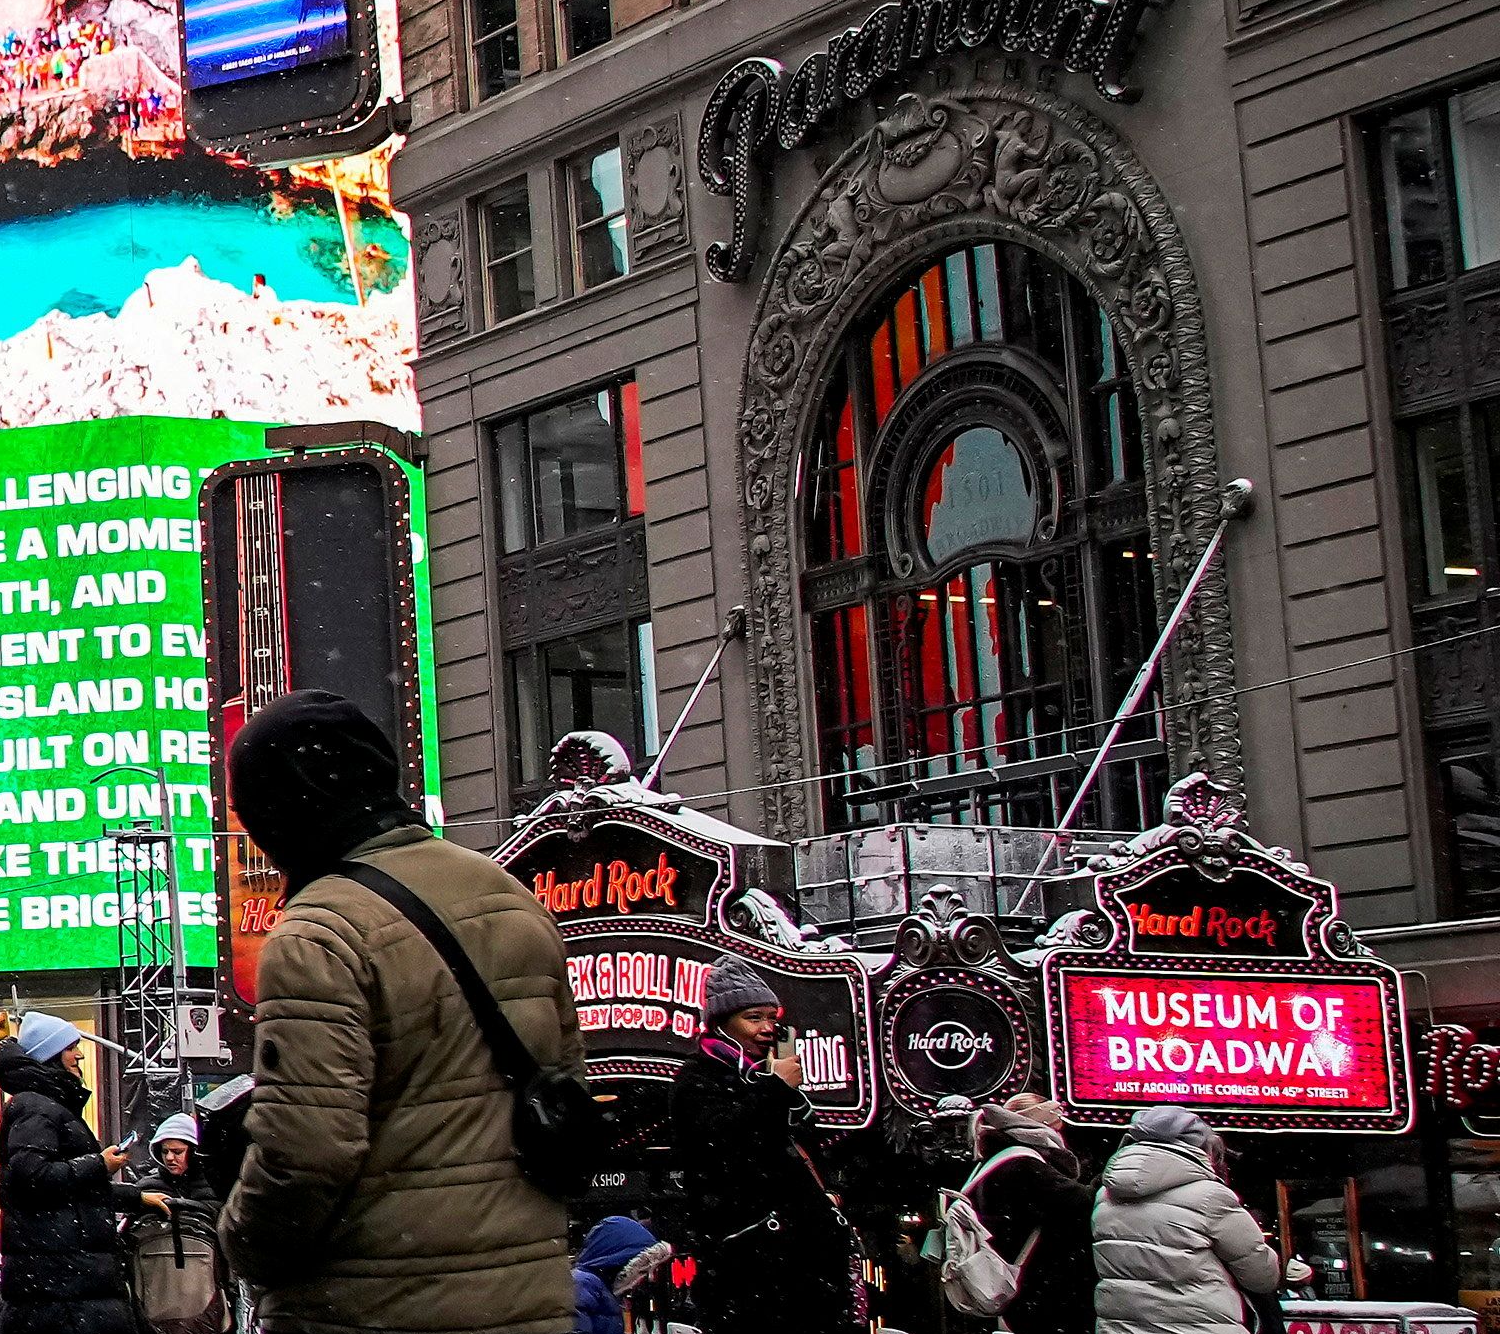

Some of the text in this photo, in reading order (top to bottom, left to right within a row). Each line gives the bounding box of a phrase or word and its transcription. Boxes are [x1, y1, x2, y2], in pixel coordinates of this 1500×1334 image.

[16, 528, 48, 561] A
[71, 570, 167, 609] AND
[94, 623, 151, 658] TO
[83, 730, 149, 767] ON
[534, 852, 677, 914] Hard Rock
[1129, 903, 1278, 948] Hard Rock
[596, 952, 673, 1001] & ROLL
[611, 1005, 695, 1038] POP UP DJ
[1105, 989, 1345, 1033] MUSEUM OF
[908, 1032, 993, 1053] Hard Rock
[1108, 1037, 1353, 1077] BROADWAY
[1112, 1081, 1280, 1097] JUST AROUND THE CORNER ON
[600, 1173, 627, 1187] SHOP
